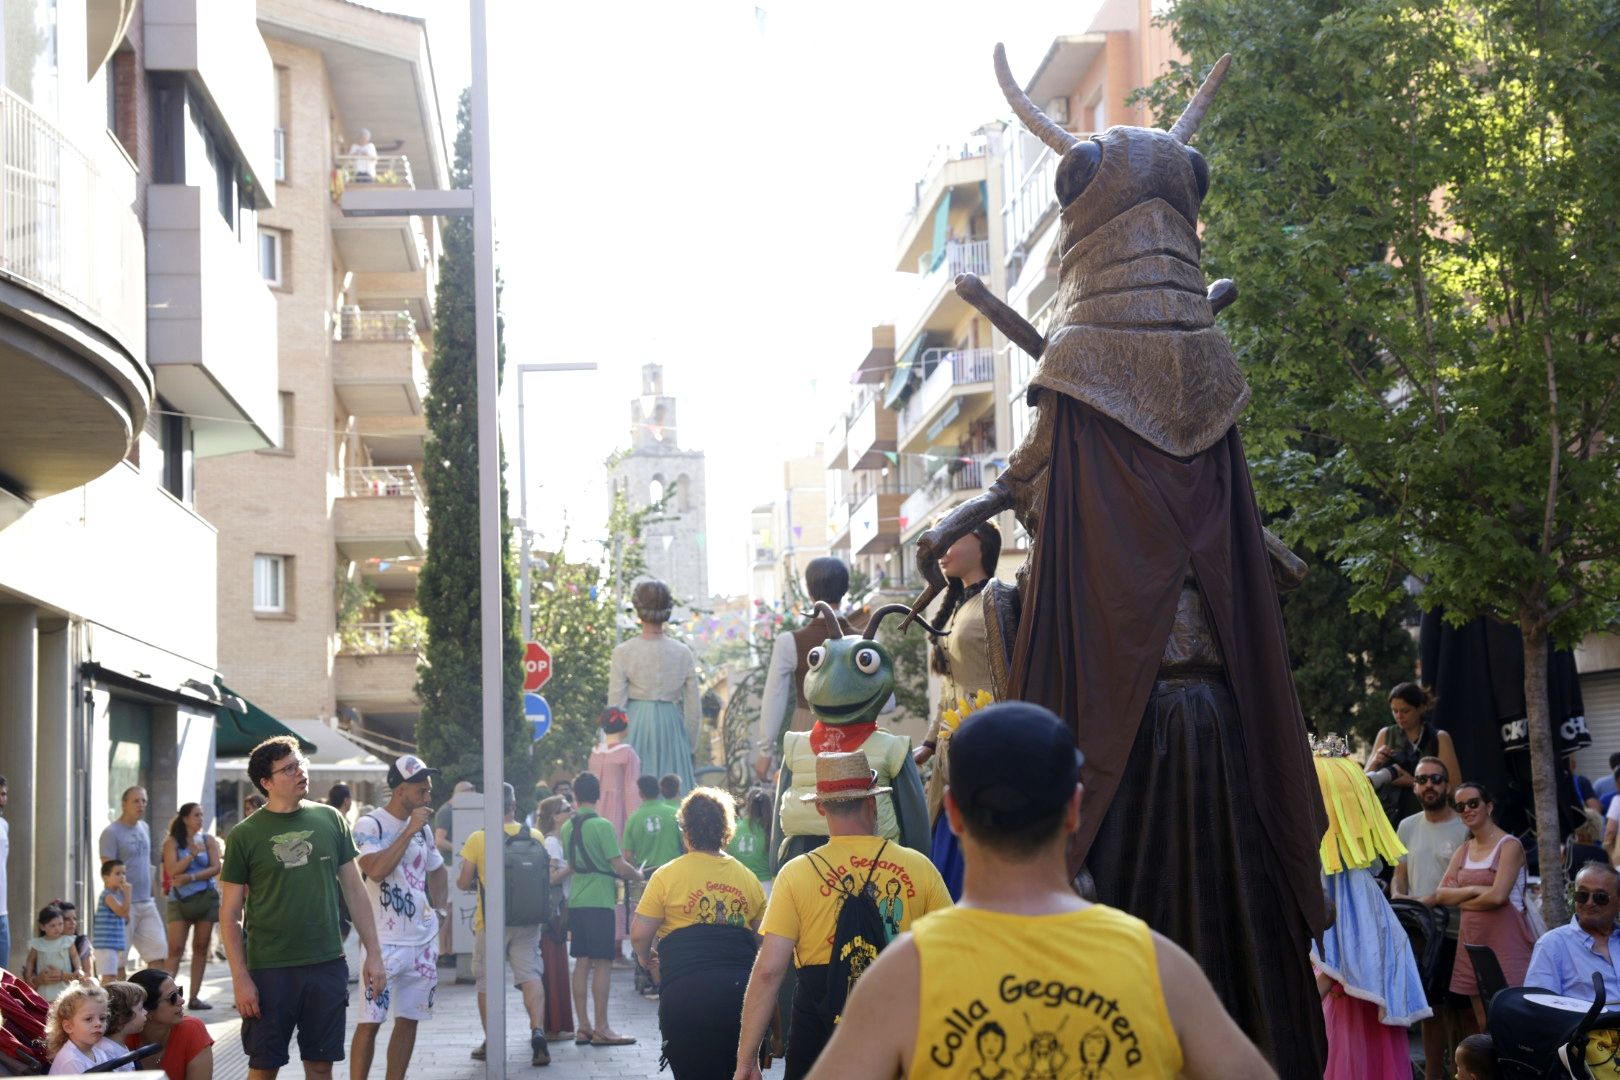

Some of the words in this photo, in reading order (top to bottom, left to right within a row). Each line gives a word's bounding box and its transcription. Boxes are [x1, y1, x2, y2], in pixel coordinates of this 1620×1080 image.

[526, 660, 548, 673] OP
[683, 889, 704, 914] Colla
[930, 1000, 990, 1069] Colla
[999, 974, 1143, 1068] Gegantera
